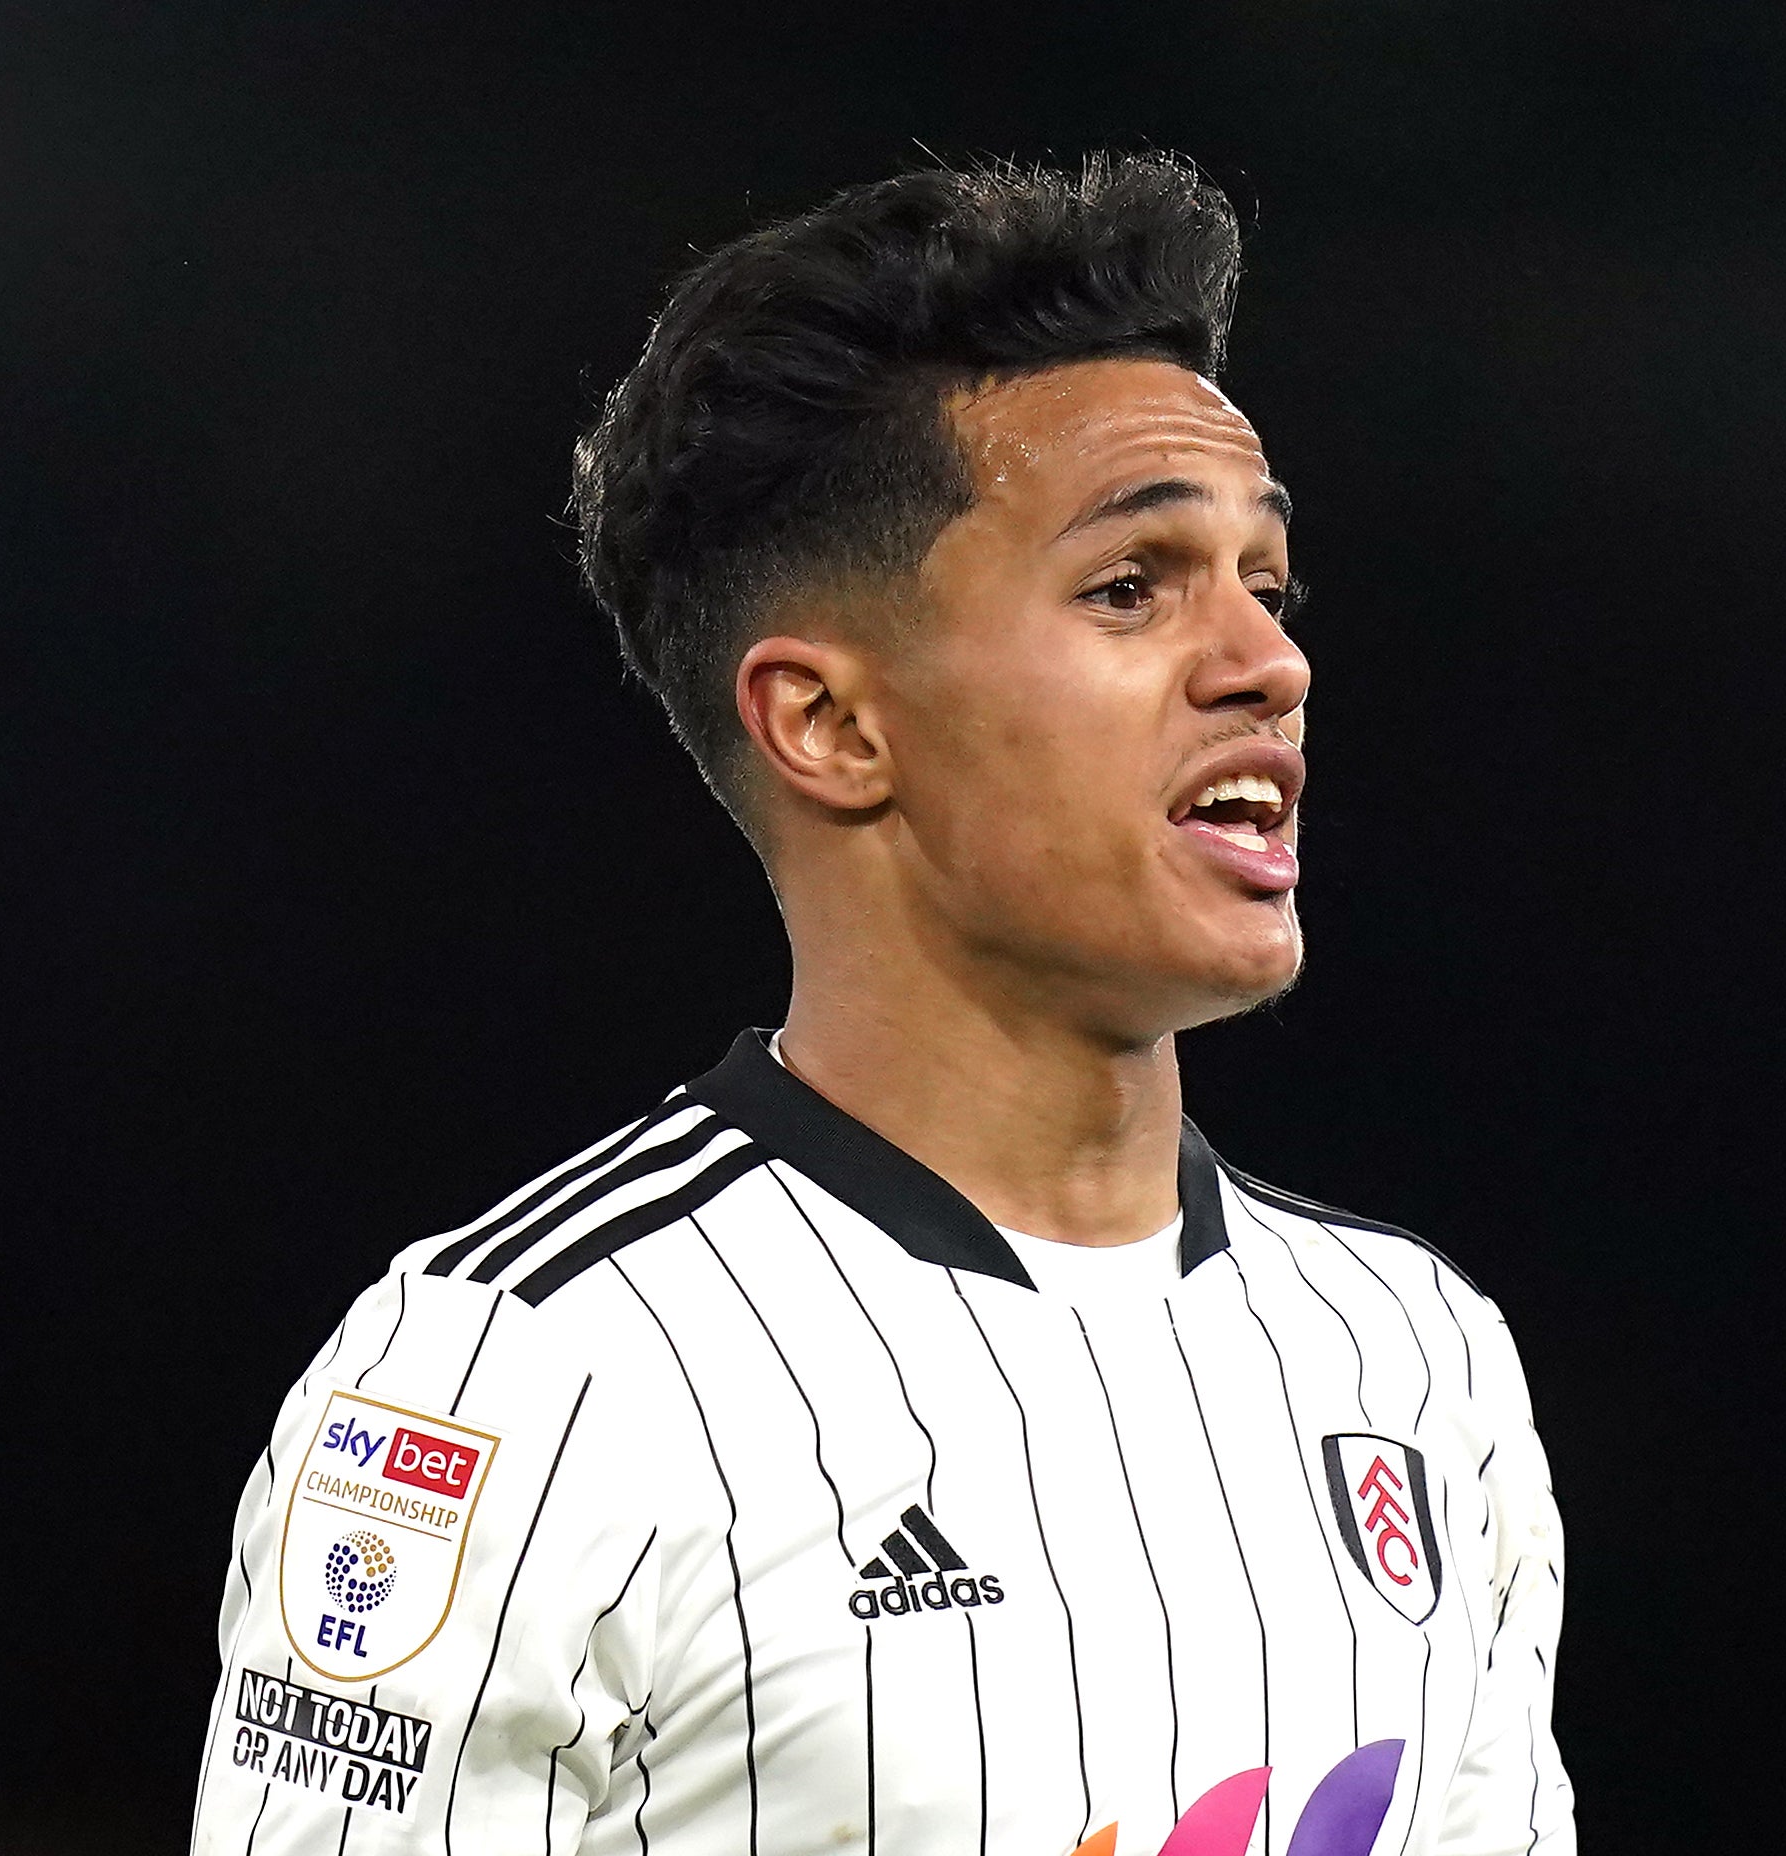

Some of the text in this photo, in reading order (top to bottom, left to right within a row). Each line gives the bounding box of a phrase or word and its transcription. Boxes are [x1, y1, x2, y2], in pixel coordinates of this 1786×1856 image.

[322, 1417, 468, 1487] sky bet
[306, 1470, 459, 1530] CHAMPIONSHIP
[848, 1571, 1005, 1620] adidas
[316, 1613, 369, 1659] EFL
[239, 1671, 430, 1767] NOT TODAY
[232, 1726, 418, 1814] OR ANY DAY
